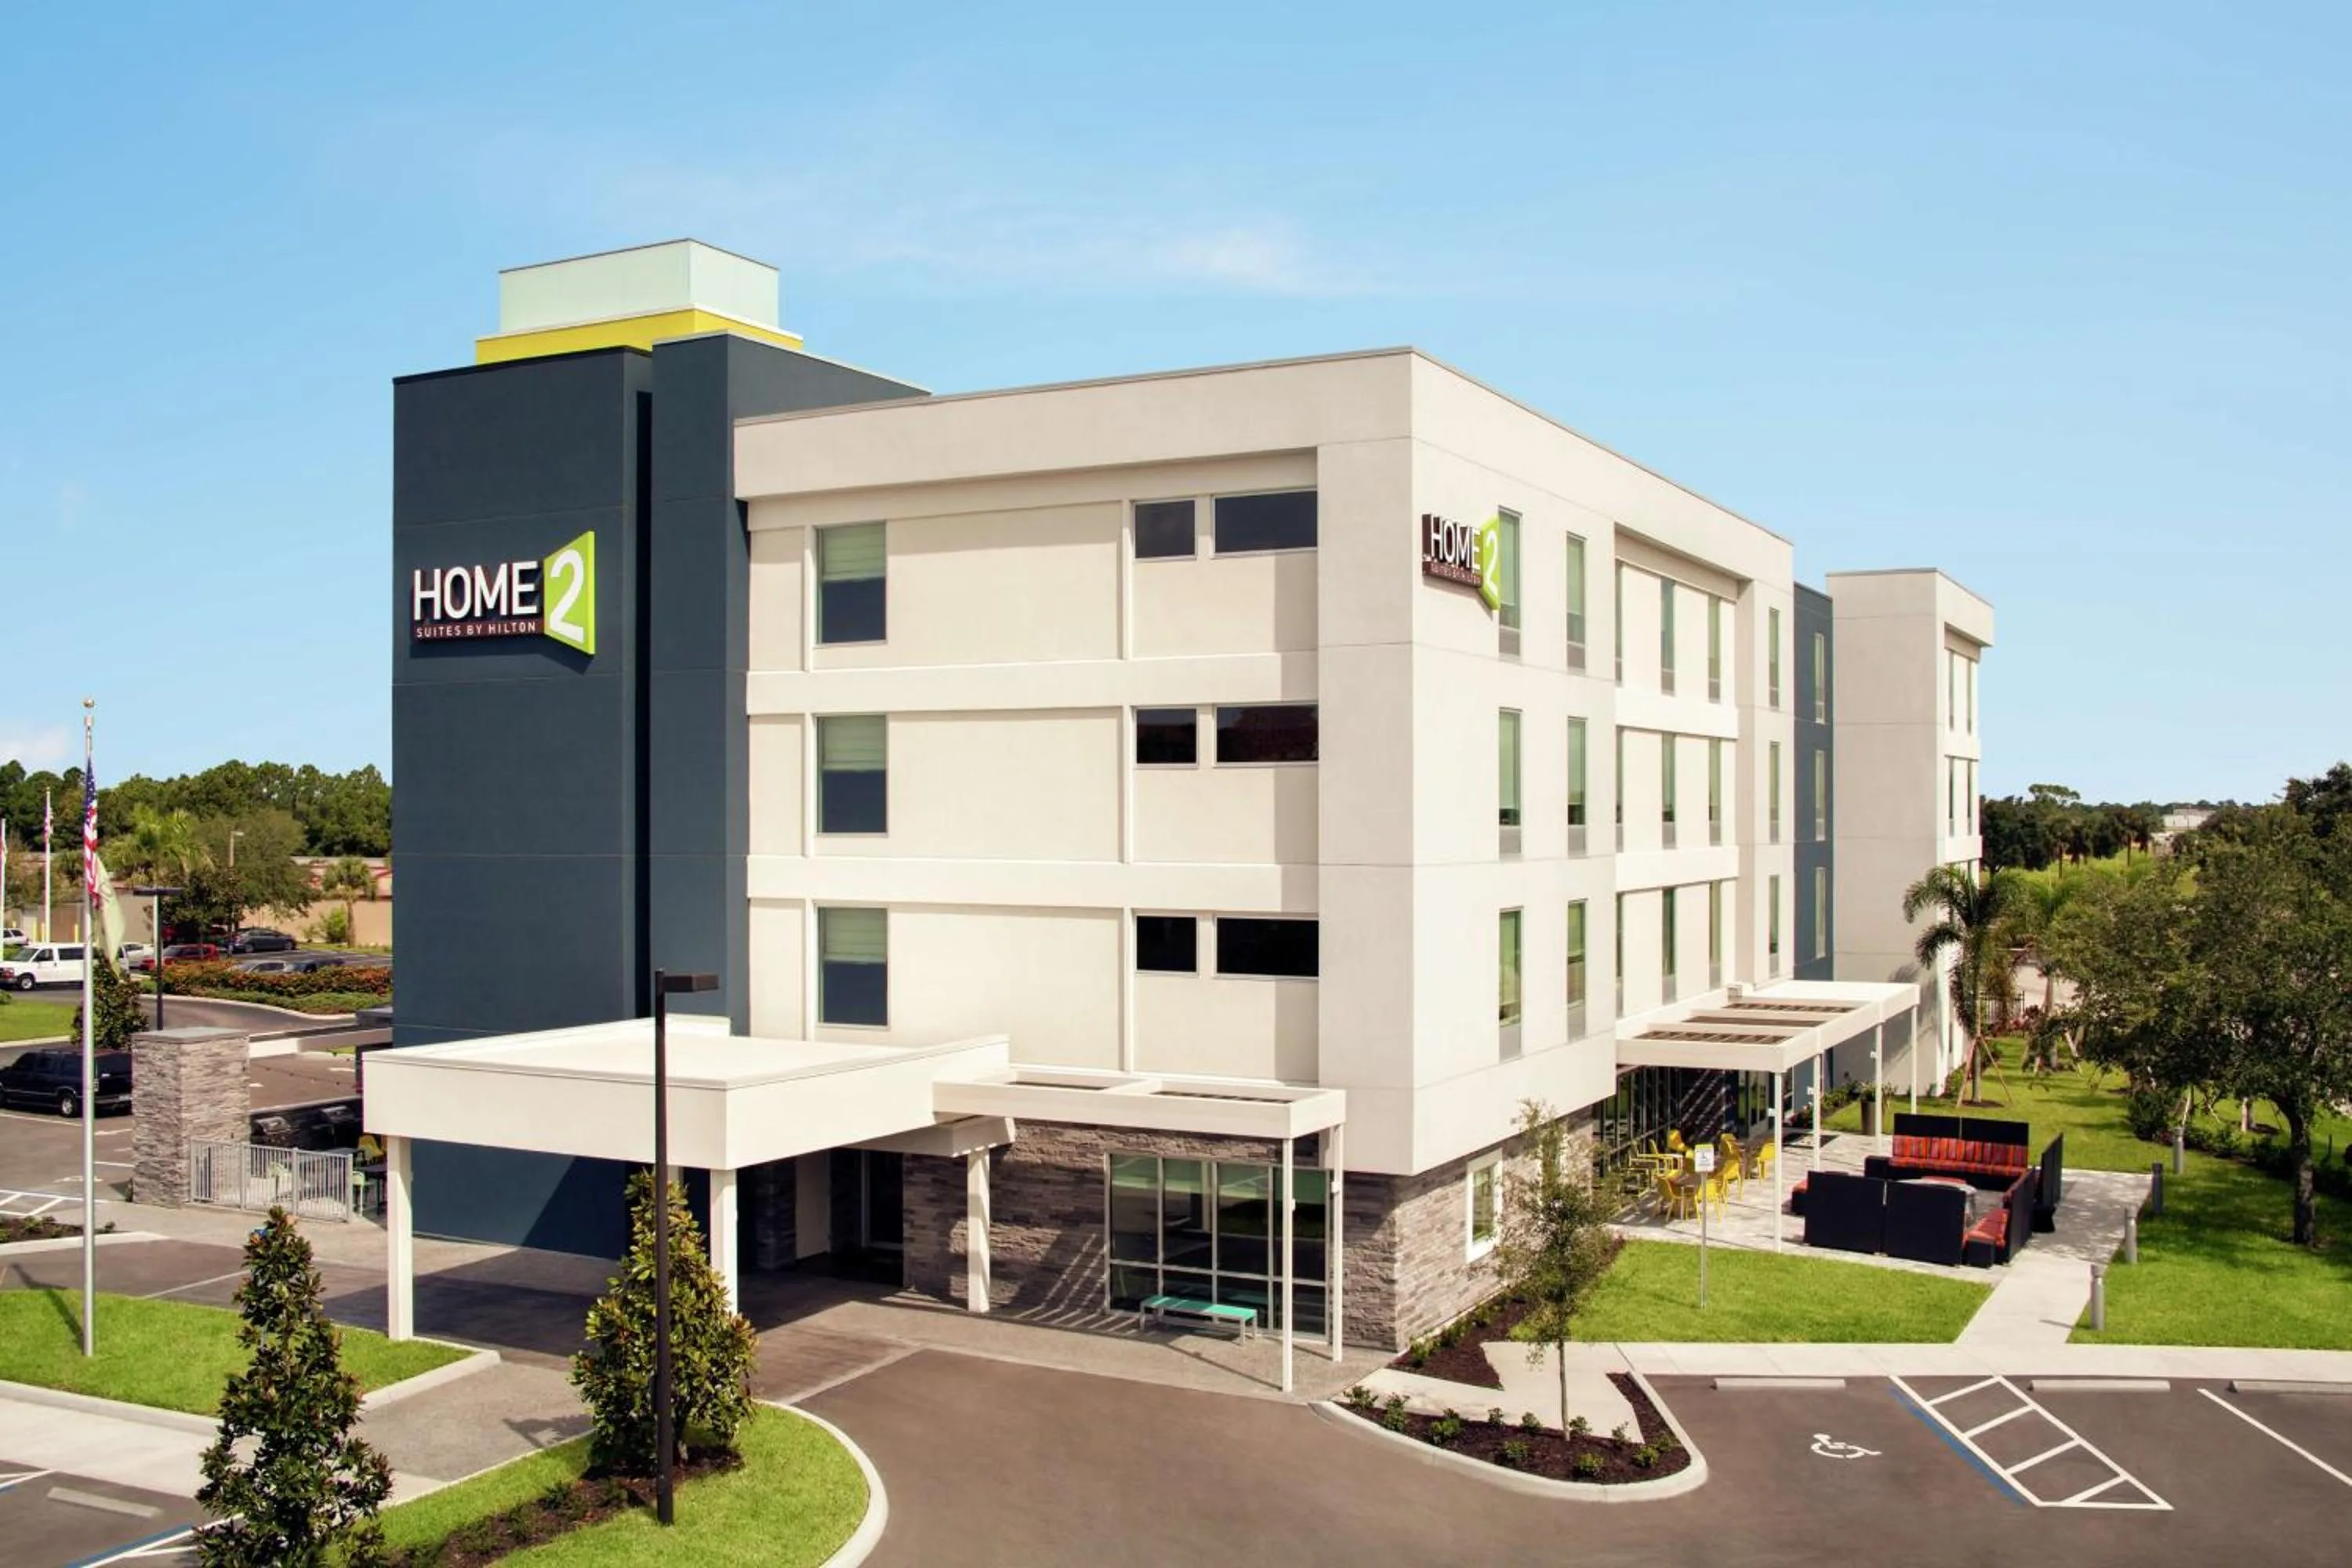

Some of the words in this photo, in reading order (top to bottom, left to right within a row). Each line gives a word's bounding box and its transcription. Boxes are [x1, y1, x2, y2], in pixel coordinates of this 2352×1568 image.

[414, 561, 538, 620] HOME
[550, 548, 584, 644] 2
[1431, 516, 1481, 570] HOME
[1486, 529, 1498, 597] 2
[416, 626, 461, 637] SUITES
[466, 624, 481, 635] BY
[488, 622, 535, 633] HILTON
